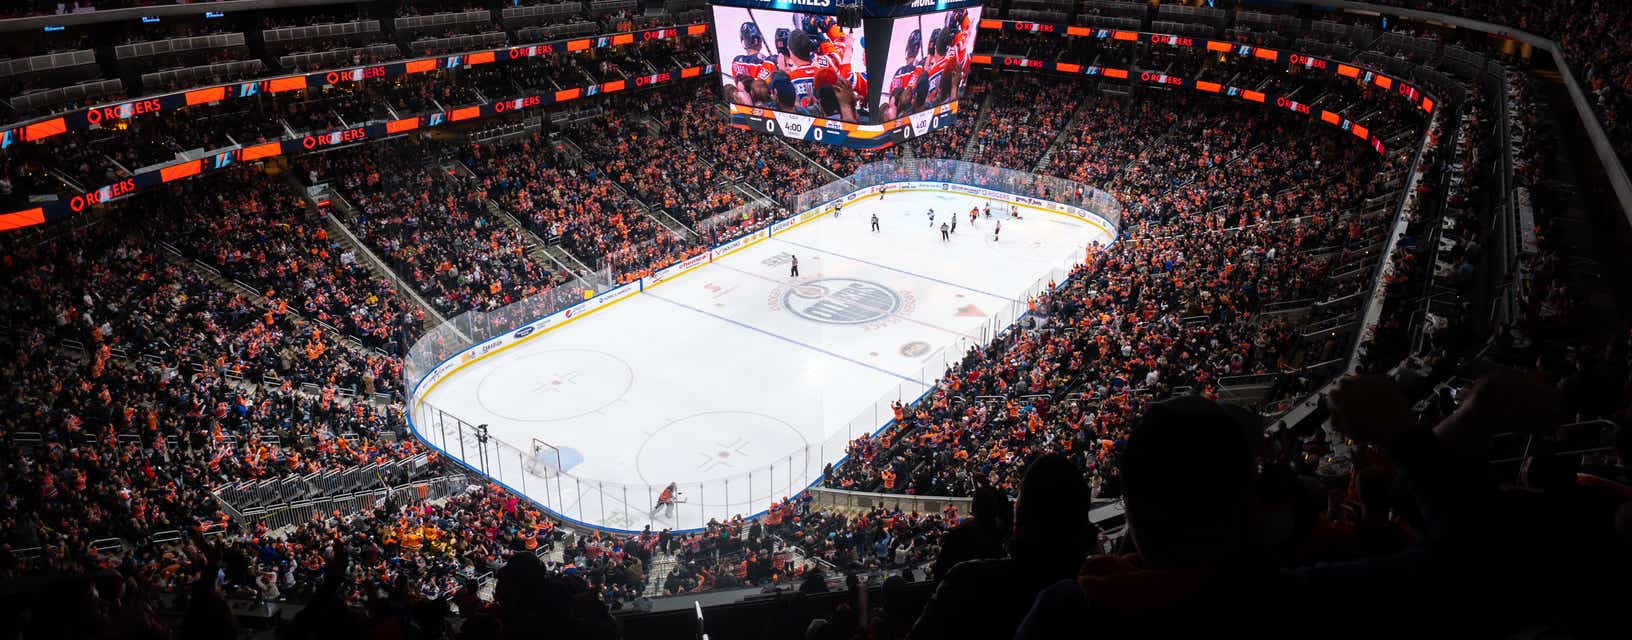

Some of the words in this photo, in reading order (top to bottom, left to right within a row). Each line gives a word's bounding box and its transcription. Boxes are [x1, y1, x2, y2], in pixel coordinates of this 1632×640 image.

[341, 66, 385, 82] ROGERS
[104, 99, 161, 120] ROGERS
[766, 119, 775, 132] 0
[785, 123, 802, 133] 4:00
[933, 116, 939, 128] 0
[318, 128, 365, 145] ROGERS
[814, 127, 823, 140] 0
[904, 126, 910, 138] 0
[86, 178, 135, 206] ROGERS
